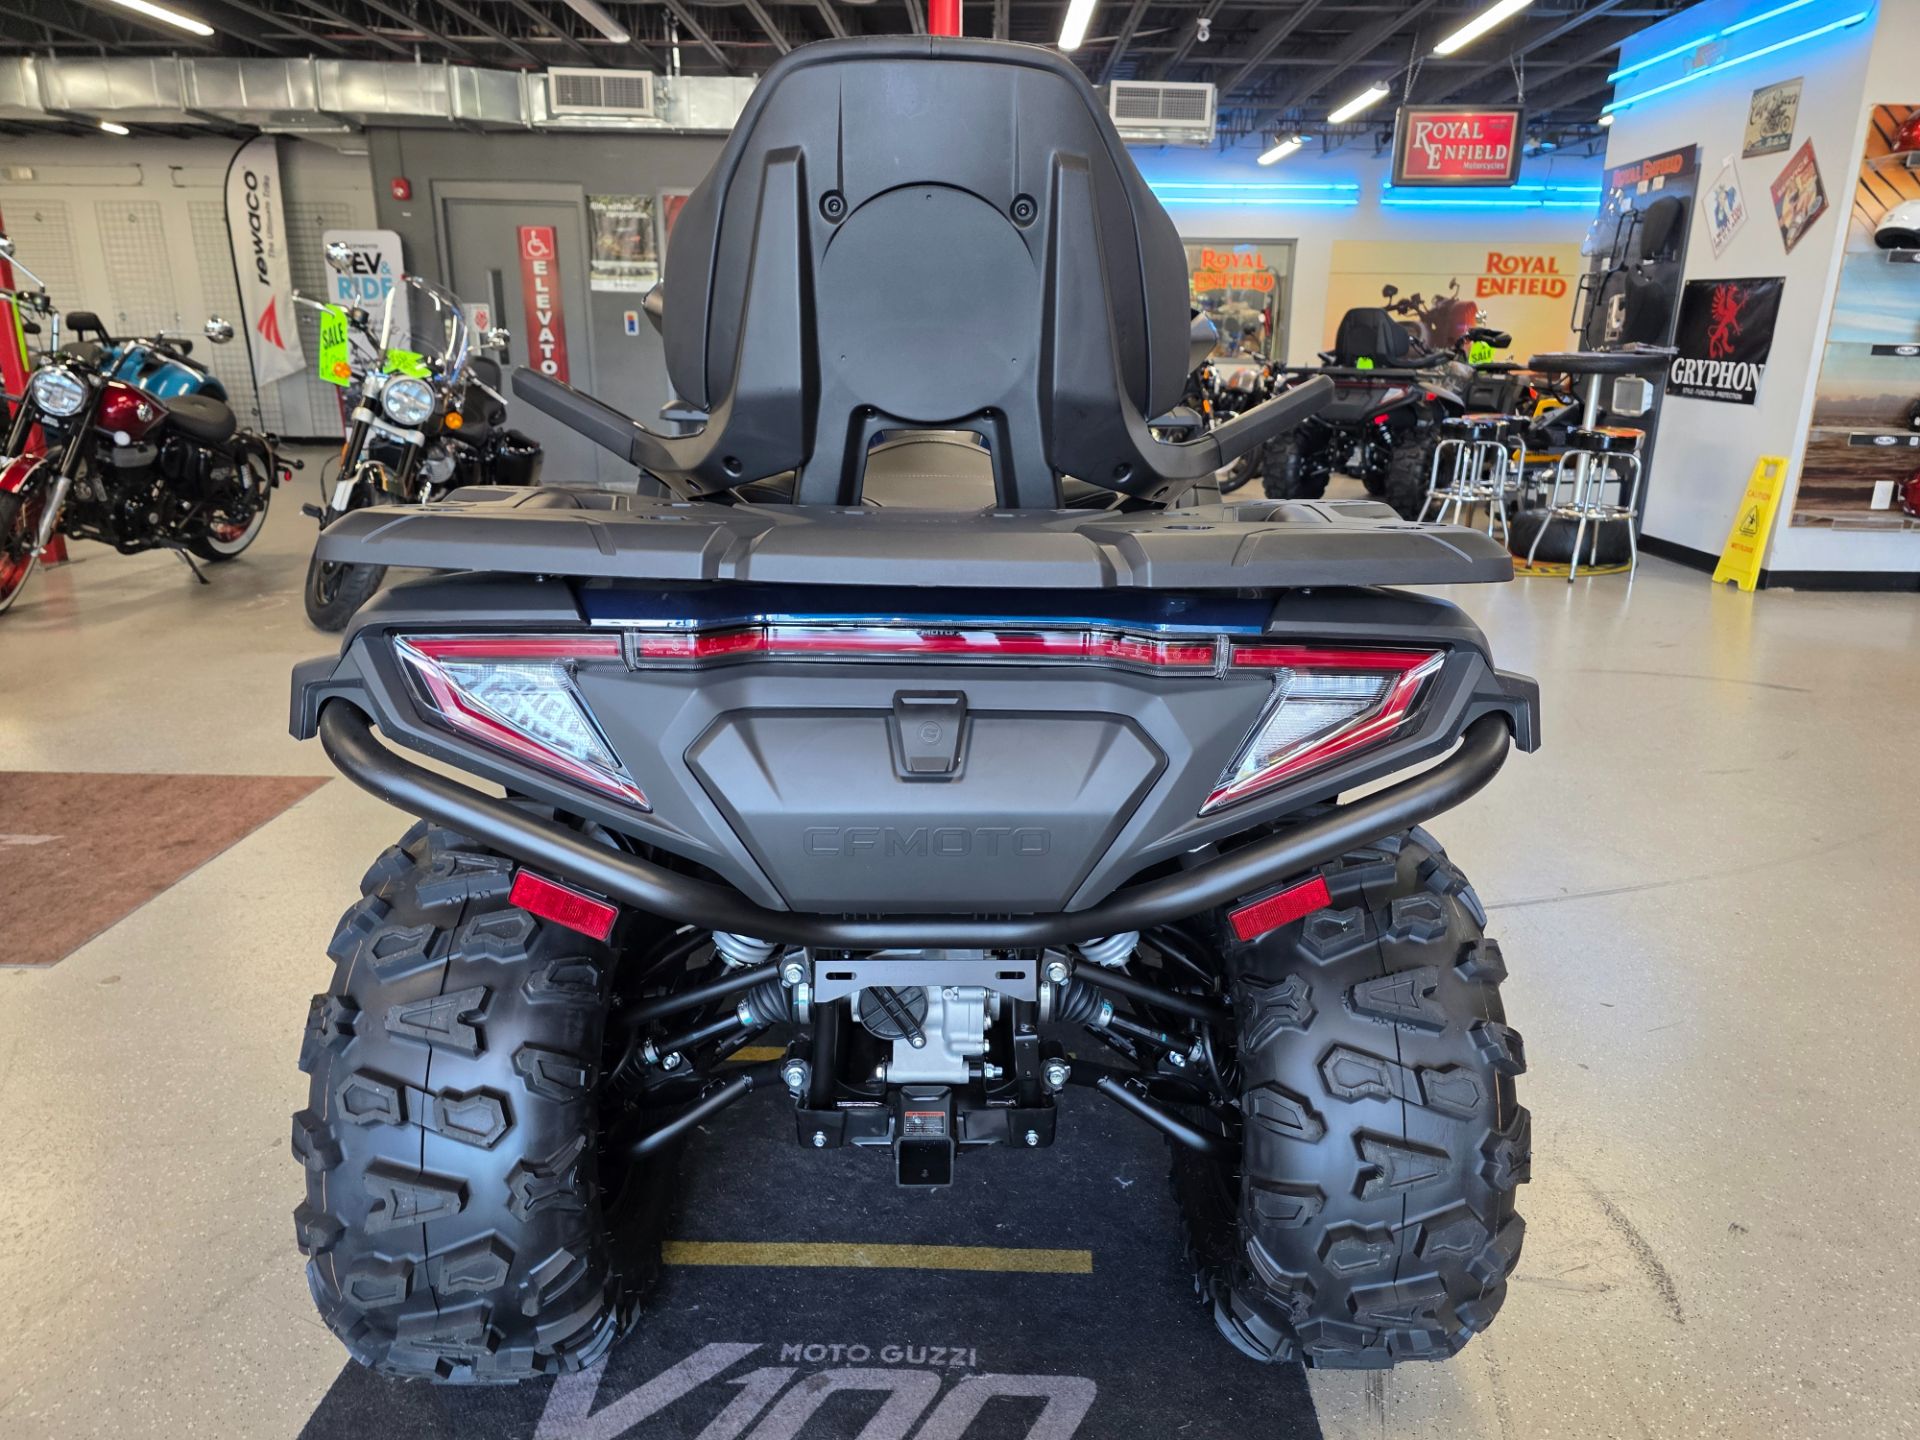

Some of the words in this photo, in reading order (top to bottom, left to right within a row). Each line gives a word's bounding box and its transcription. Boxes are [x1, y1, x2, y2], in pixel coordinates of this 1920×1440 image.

[1413, 121, 1484, 150] ROYAL
[1426, 143, 1507, 170] ENFIELD
[1463, 162, 1505, 171] Motorcycles
[244, 170, 270, 286] rewaco
[268, 242, 276, 258] The
[1201, 247, 1267, 272] ROYAL
[1486, 251, 1559, 275] ROYAL
[338, 277, 394, 300] RIDE
[1193, 271, 1275, 293] ENFIELD
[1476, 277, 1568, 299] ENFIELD
[532, 261, 558, 375] ELEVATO
[322, 322, 345, 350] SALE
[1671, 357, 1765, 391] GRYPHON
[803, 826, 1051, 857] CFMOTO
[780, 1343, 870, 1363] MOTO
[881, 1345, 977, 1368] GUZZI
